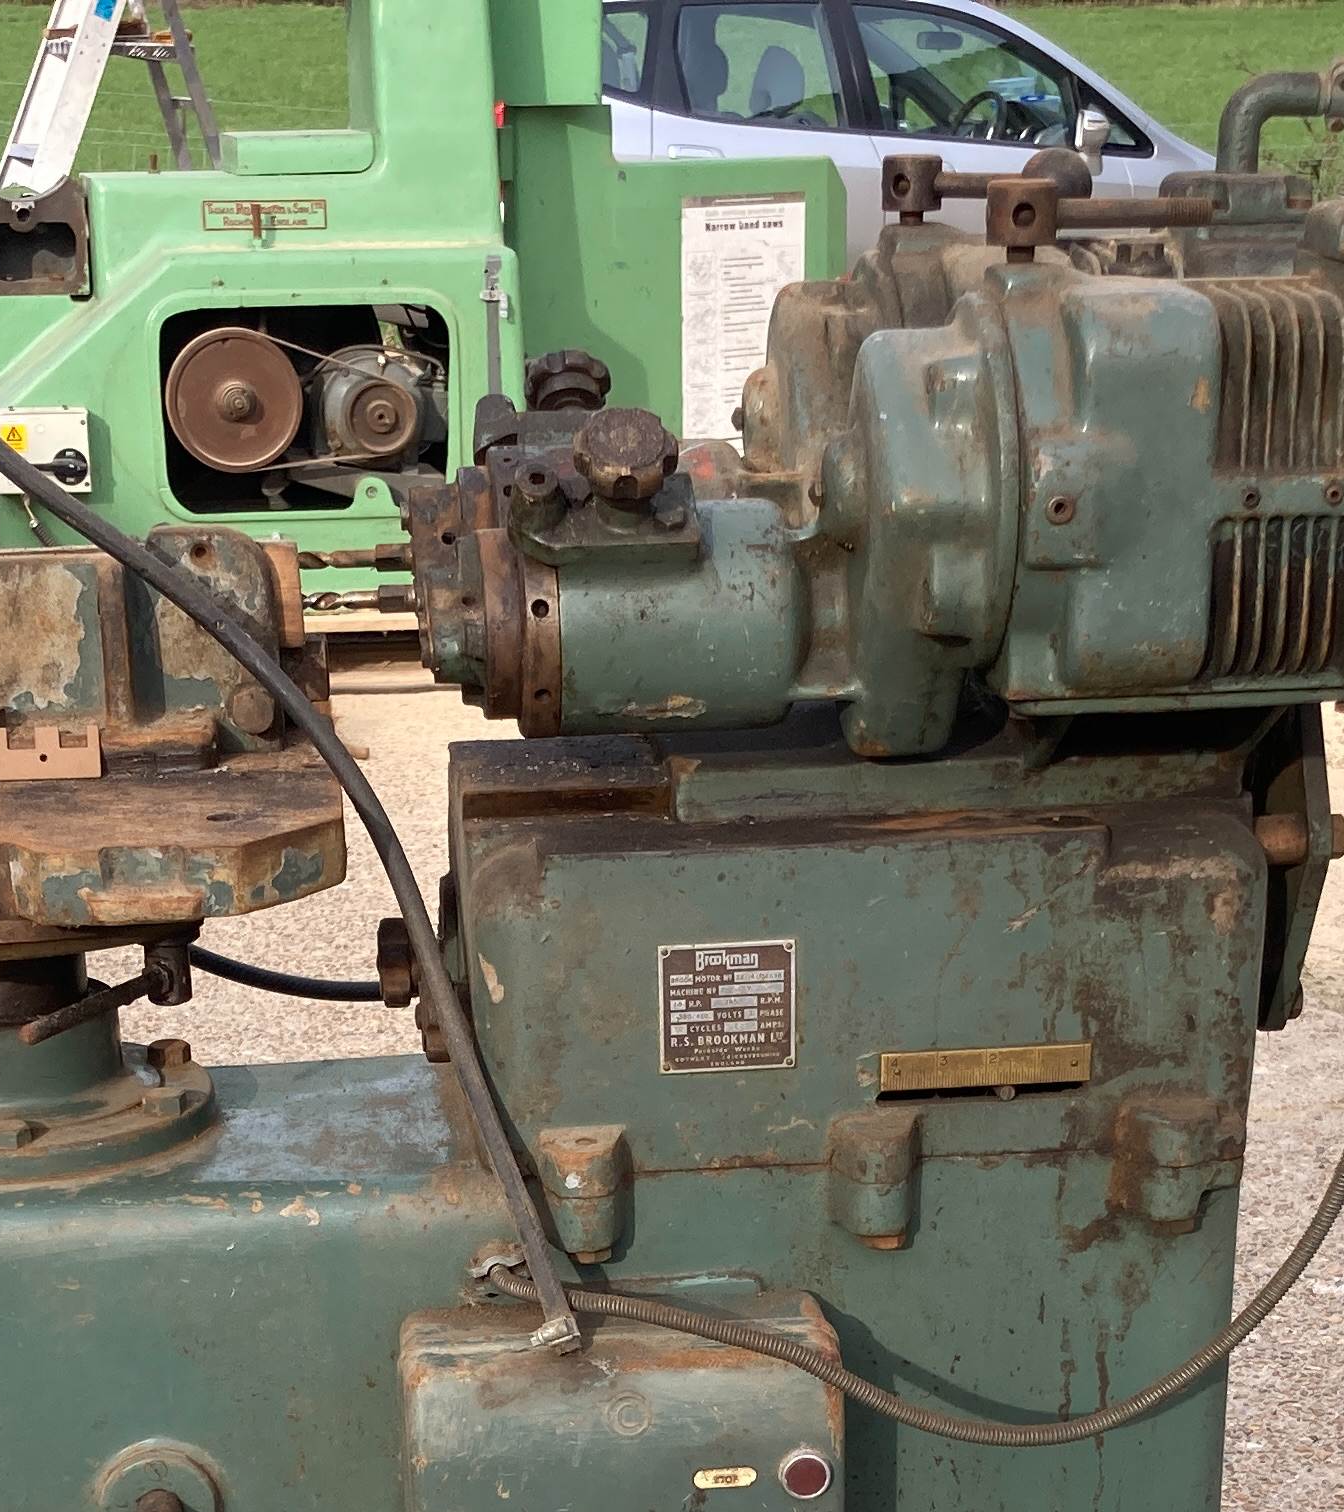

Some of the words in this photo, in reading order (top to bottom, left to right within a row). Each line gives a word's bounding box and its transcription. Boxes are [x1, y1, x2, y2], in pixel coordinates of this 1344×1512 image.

[705, 222, 736, 232] Narrow
[739, 220, 760, 230] band
[762, 220, 783, 229] saws
[696, 950, 758, 971] Brookman
[695, 974, 722, 983] MOTOR
[670, 987, 704, 997] MACHINE
[716, 1010, 742, 1019] VOLTS
[689, 1023, 722, 1033] CYCLES
[670, 1036, 694, 1048] R.S.
[697, 1033, 765, 1046] BROOKMAN
[891, 1058, 898, 1067] 4
[940, 1056, 948, 1066] 3
[989, 1053, 998, 1064] 2
